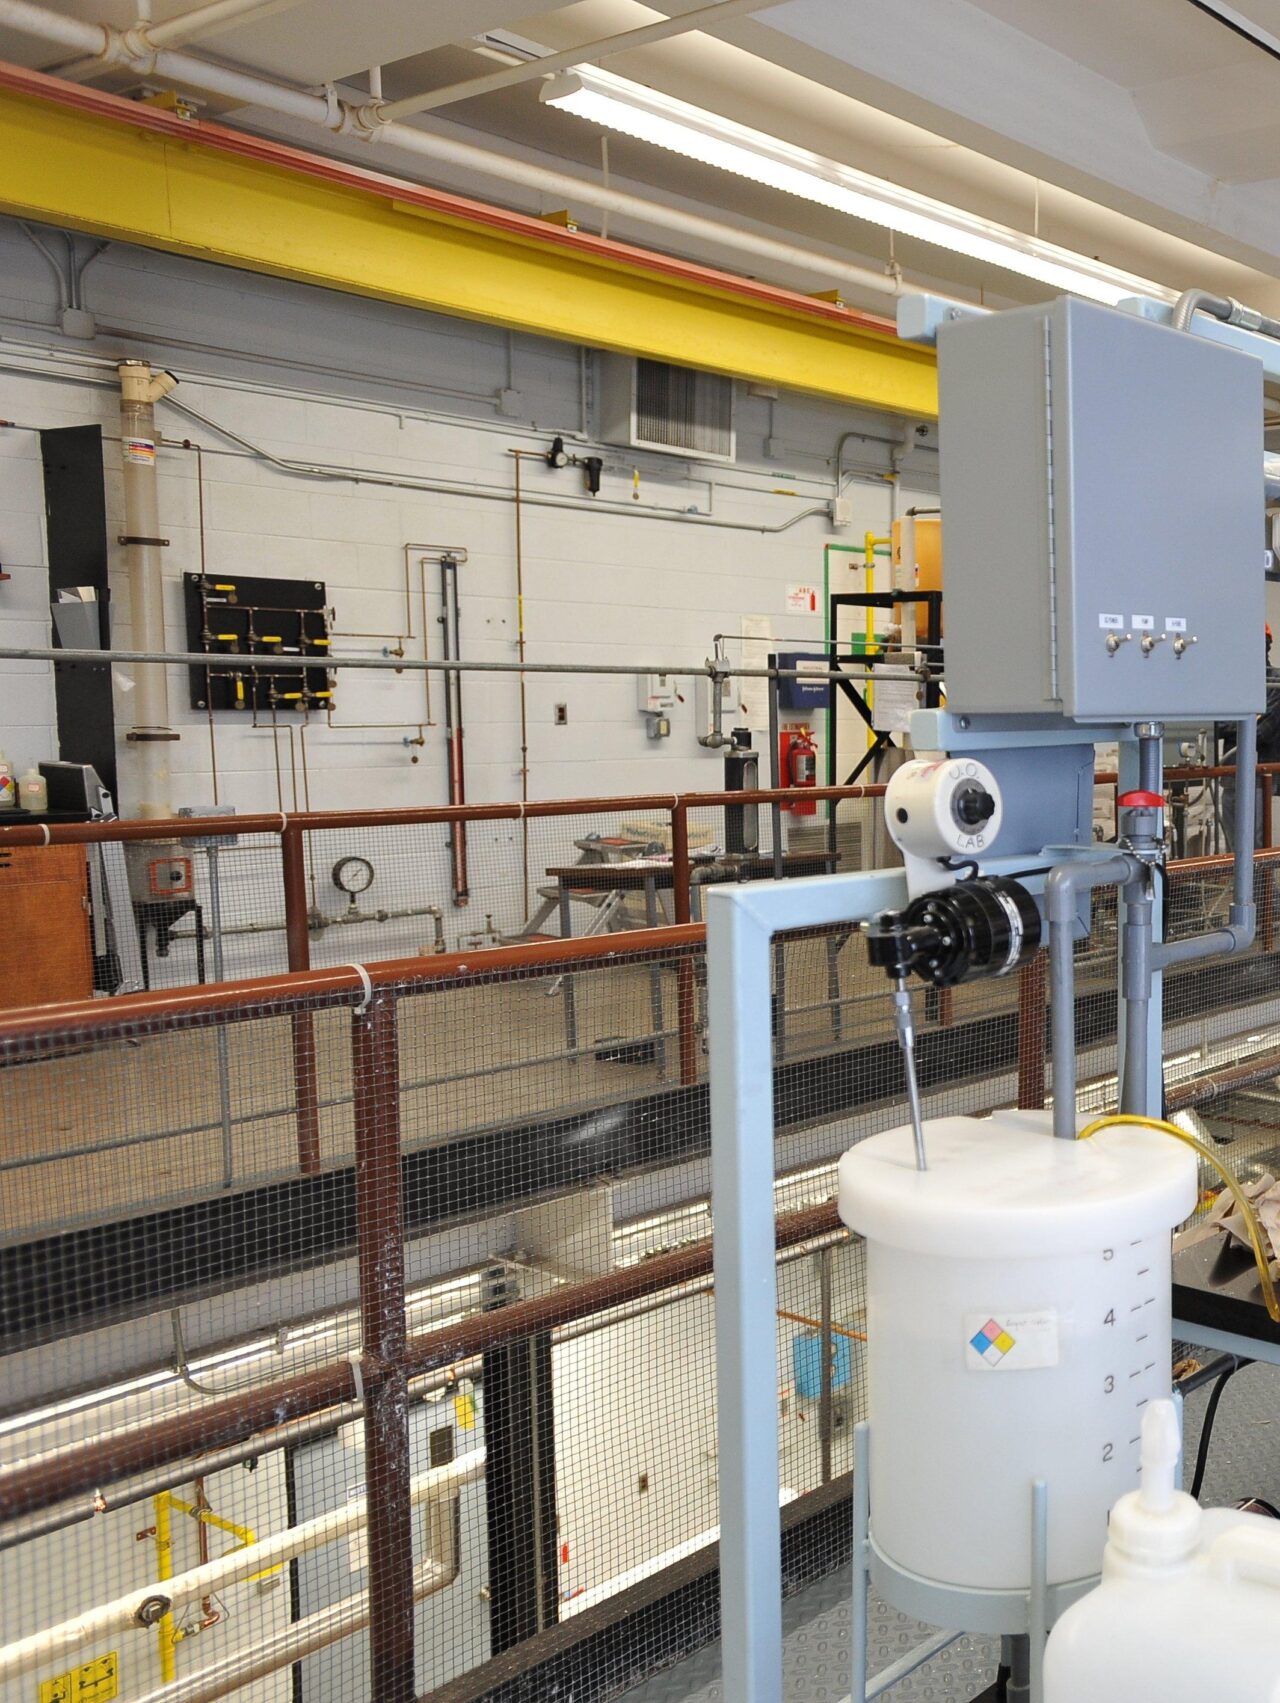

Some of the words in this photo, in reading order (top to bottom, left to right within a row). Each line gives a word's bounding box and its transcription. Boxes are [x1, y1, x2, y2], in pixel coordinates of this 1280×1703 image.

[956, 834, 986, 849] LAB
[1103, 1308, 1116, 1326] 4
[1104, 1375, 1114, 1394] 3
[1102, 1443, 1113, 1462] 2
